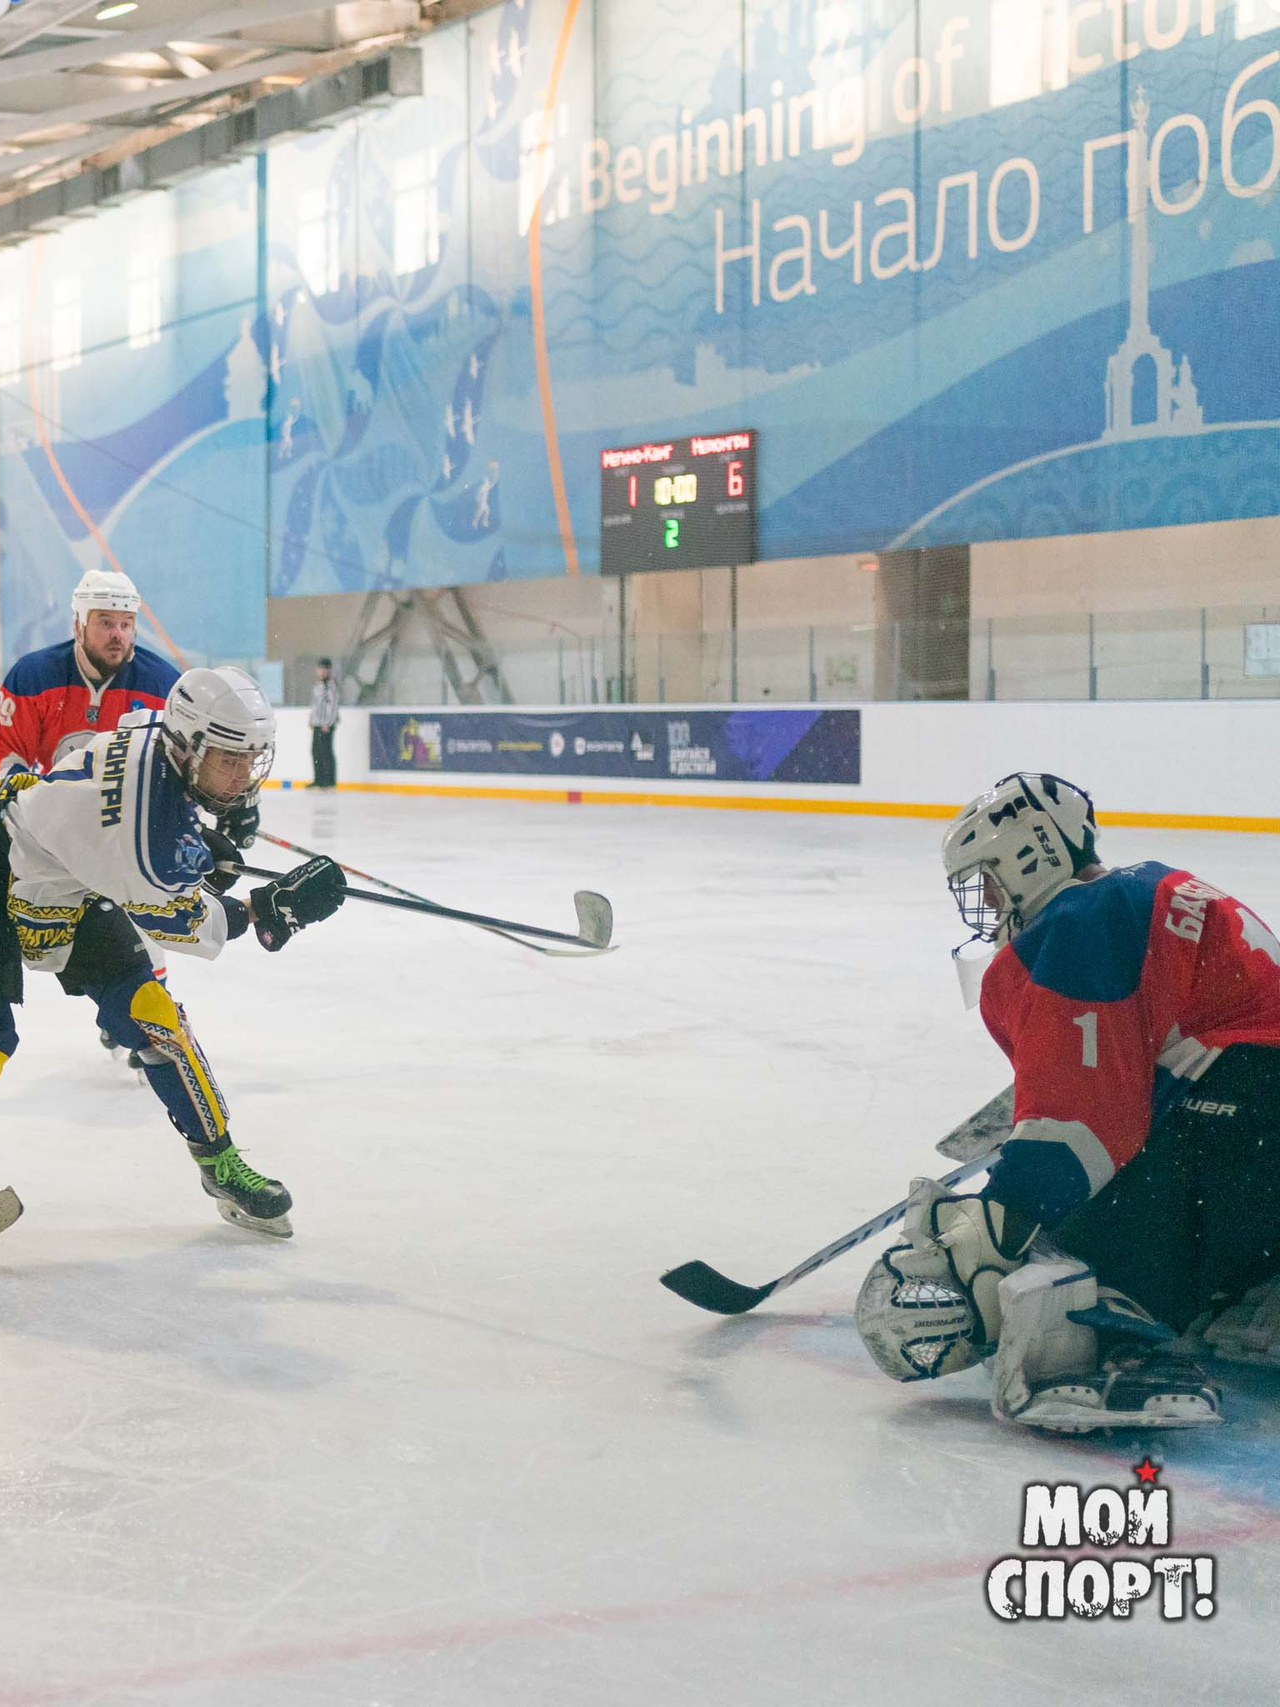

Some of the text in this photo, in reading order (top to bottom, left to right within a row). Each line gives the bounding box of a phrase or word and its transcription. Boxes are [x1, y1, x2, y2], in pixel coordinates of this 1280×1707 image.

[580, 77, 866, 217] Beginning
[893, 16, 971, 122] of
[715, 157, 1040, 314] Начало
[629, 474, 637, 507] 1
[727, 461, 743, 497] 6
[665, 519, 679, 548] 2
[1032, 824, 1061, 867] EFSI
[1073, 1011, 1098, 1068] 1
